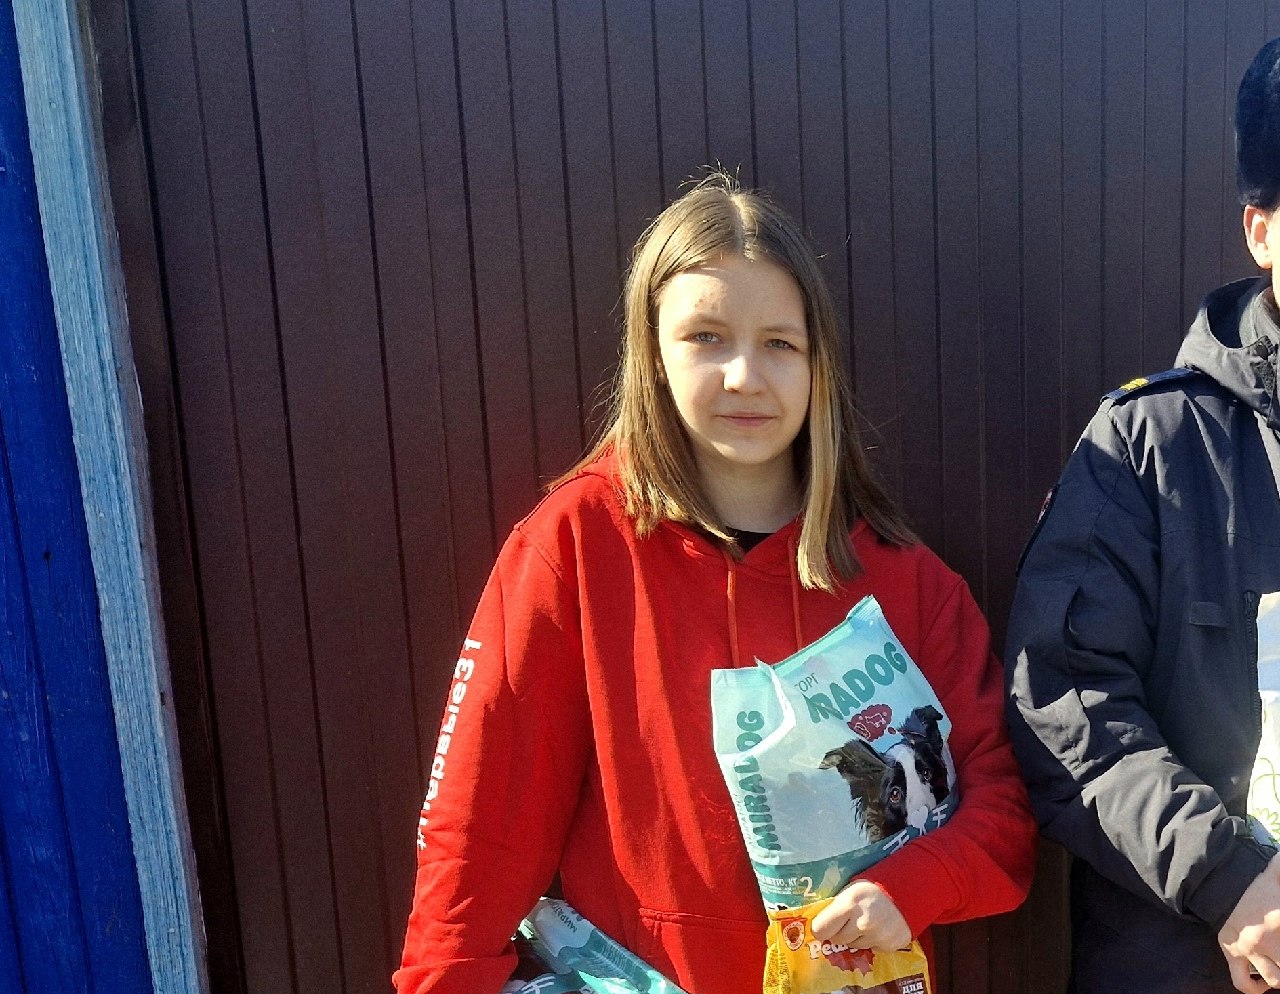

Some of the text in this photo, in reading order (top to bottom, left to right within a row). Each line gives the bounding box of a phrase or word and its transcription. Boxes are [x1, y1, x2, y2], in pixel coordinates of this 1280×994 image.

[793, 672, 818, 693] ОРГ
[802, 641, 908, 724] RADOG
[800, 876, 816, 896] 2
